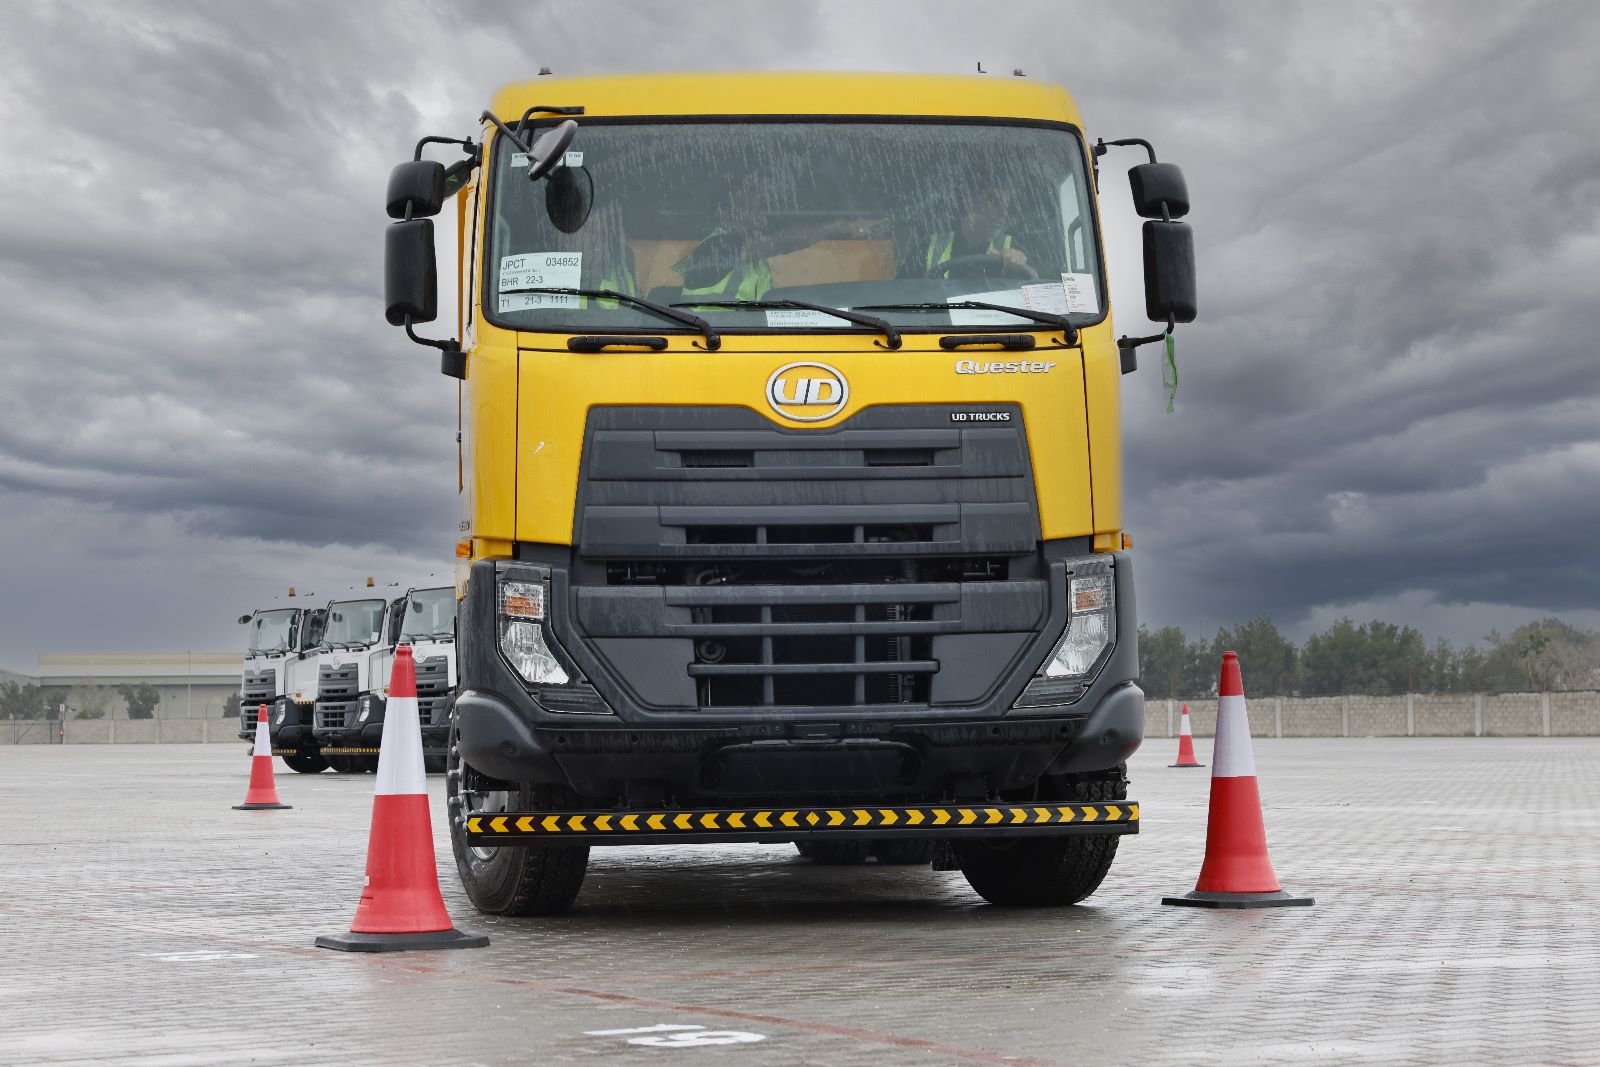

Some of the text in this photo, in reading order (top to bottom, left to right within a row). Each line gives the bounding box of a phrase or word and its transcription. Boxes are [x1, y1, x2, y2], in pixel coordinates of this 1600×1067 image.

[502, 257, 579, 270] JPCT 034852
[502, 275, 544, 287] BHR 22-3
[524, 296, 542, 305] 21-3
[955, 360, 1057, 375] Quester
[773, 378, 842, 405] UD
[951, 412, 1010, 421] UD TRUCKS
